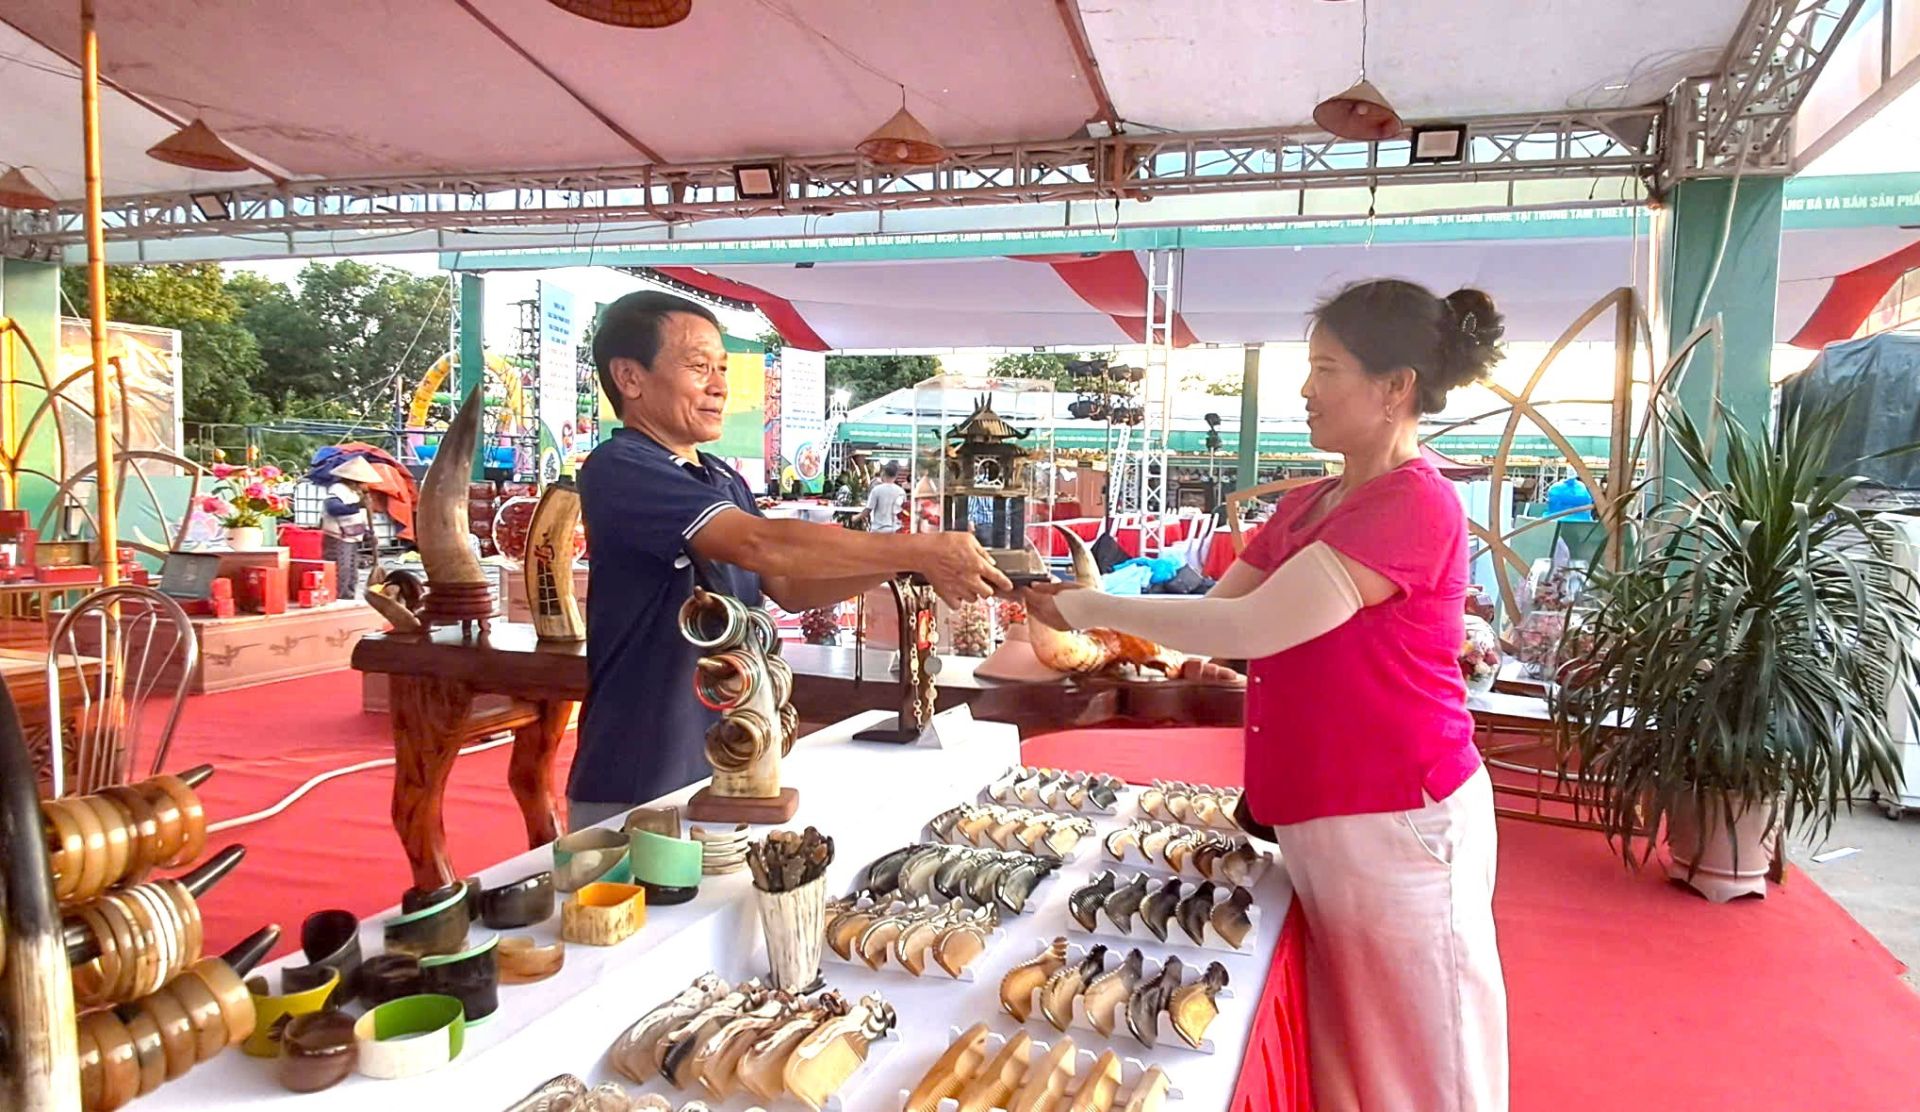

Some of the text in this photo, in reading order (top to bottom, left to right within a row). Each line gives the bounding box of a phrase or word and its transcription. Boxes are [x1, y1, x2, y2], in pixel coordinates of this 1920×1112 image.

[1825, 195, 1841, 209] VÀ
[1843, 194, 1867, 208] BÁN
[1534, 210, 1567, 221] TRUNG
